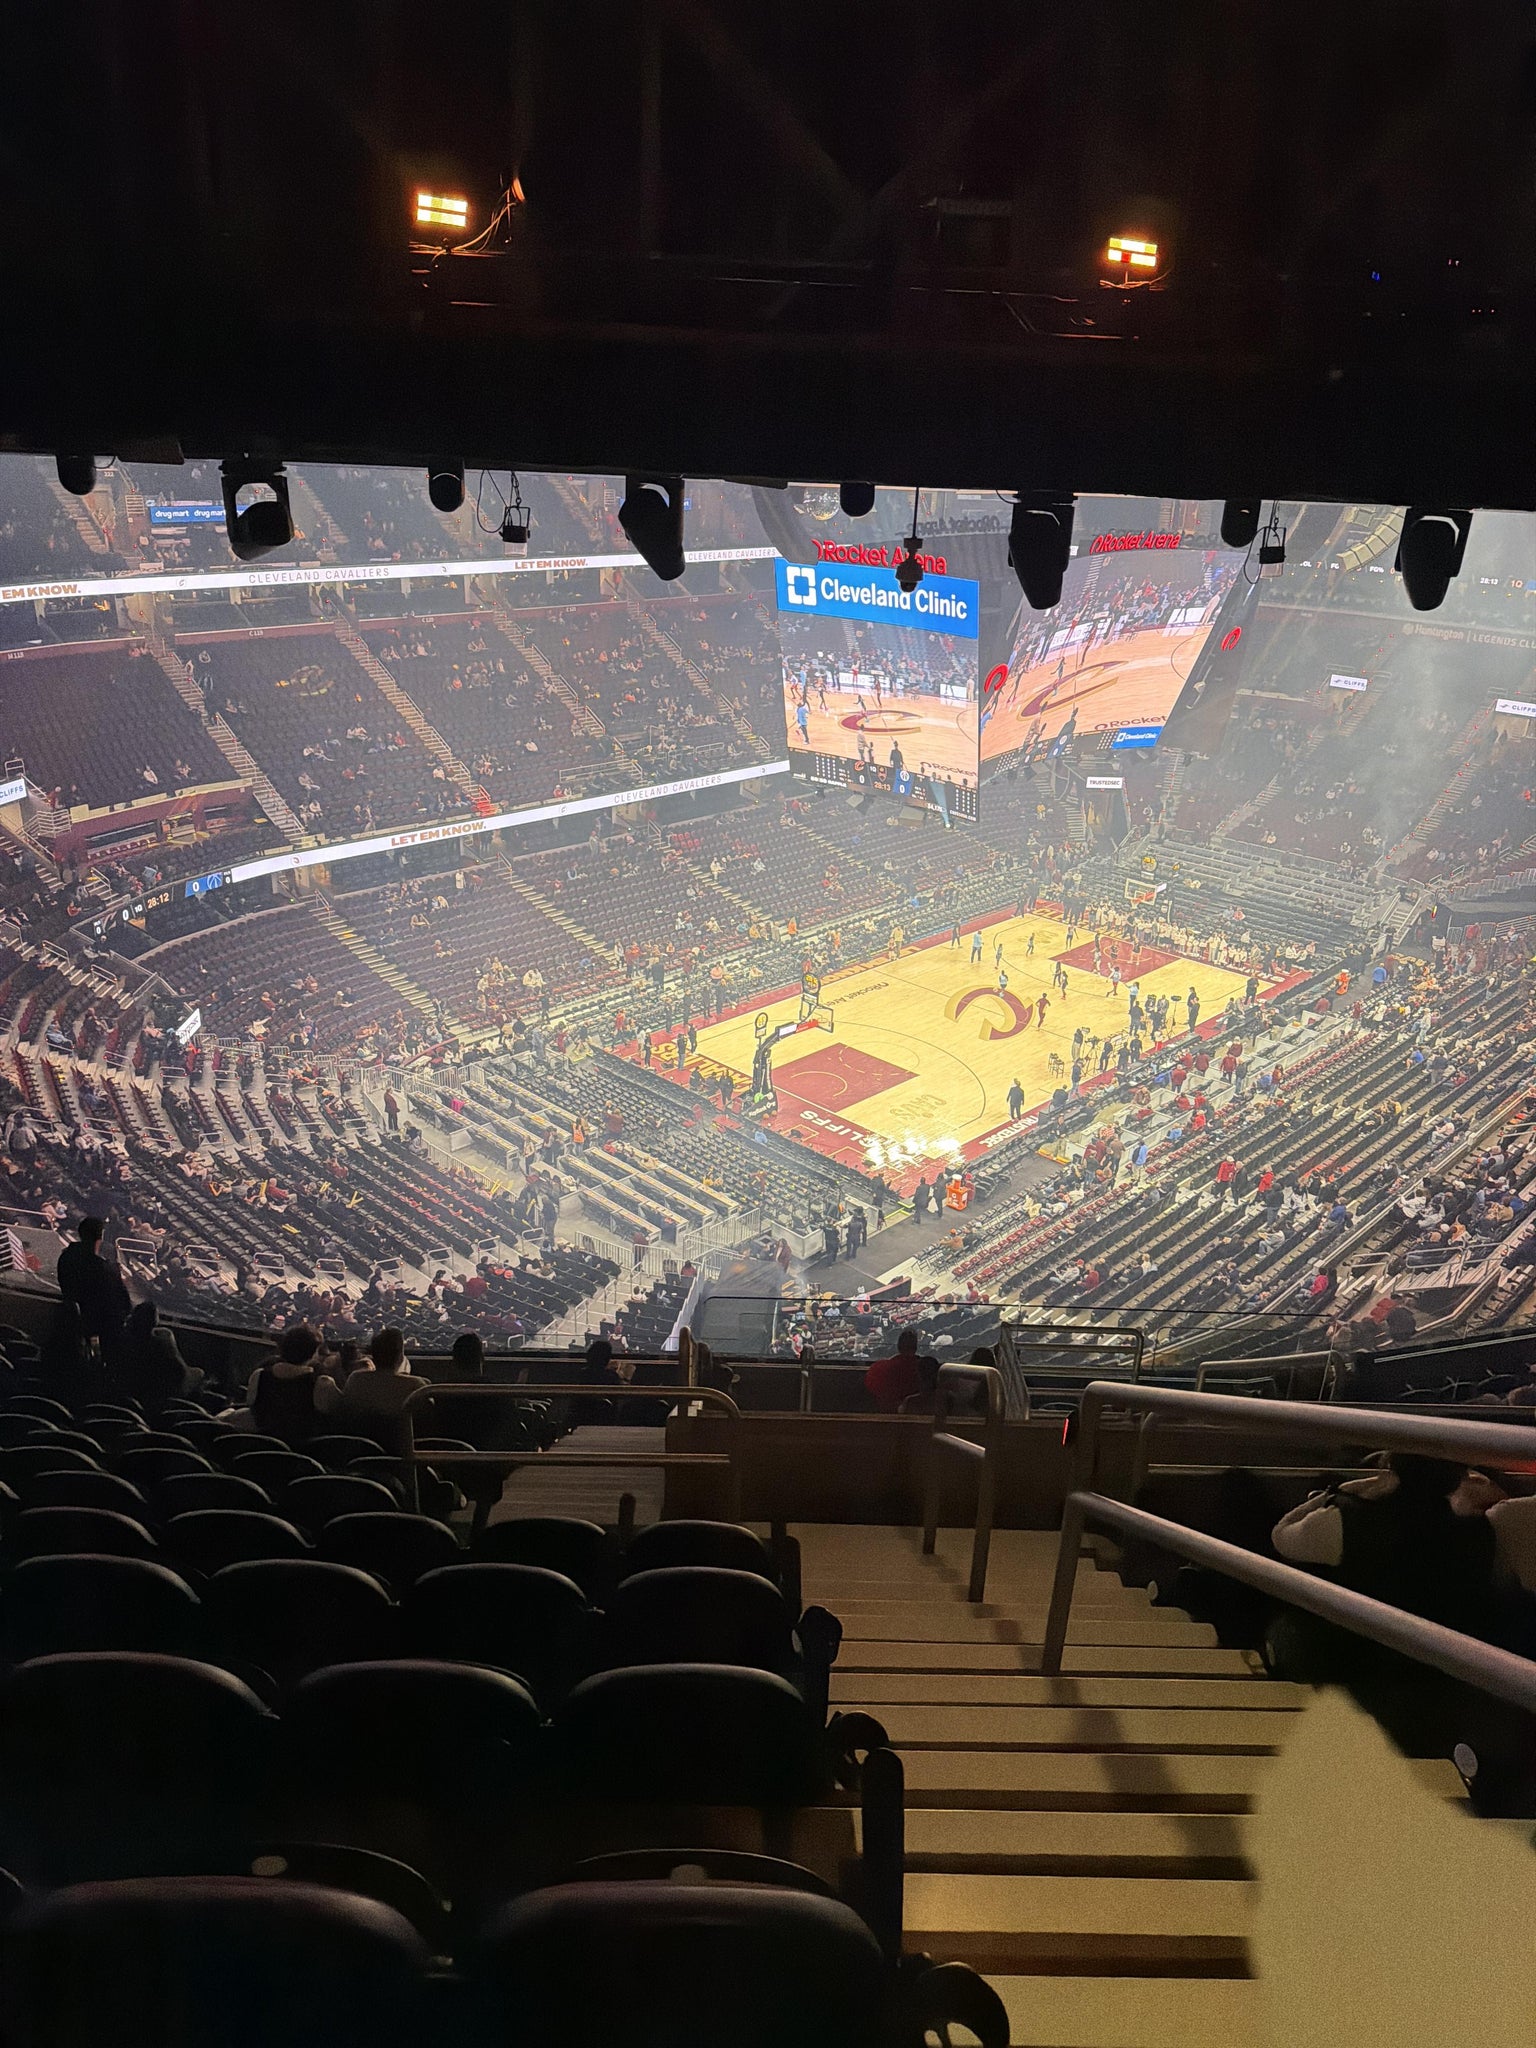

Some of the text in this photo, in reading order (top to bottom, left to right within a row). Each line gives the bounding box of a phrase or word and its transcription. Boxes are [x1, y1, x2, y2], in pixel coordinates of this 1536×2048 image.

[155, 509, 190, 519] drug mart
[194, 509, 210, 518] drug
[1100, 531, 1146, 553] Rocket
[1142, 531, 1182, 550] Arena
[688, 549, 777, 561] CLEVELAND CAVALIERS
[824, 540, 947, 575] Rocket Aena
[515, 561, 535, 570] LET
[537, 560, 552, 568] EM
[249, 567, 390, 584] CLEVELAND CAVALIERS
[2, 587, 25, 600] EM
[820, 578, 967, 620] Cleveland Clinic
[1415, 624, 1464, 640] Huntington
[1110, 715, 1168, 728] Rocket
[0, 785, 24, 798] CLIFFS
[614, 775, 722, 804] CLEVELAND CAVALIERS
[391, 834, 418, 847] LET
[420, 830, 440, 841] EM
